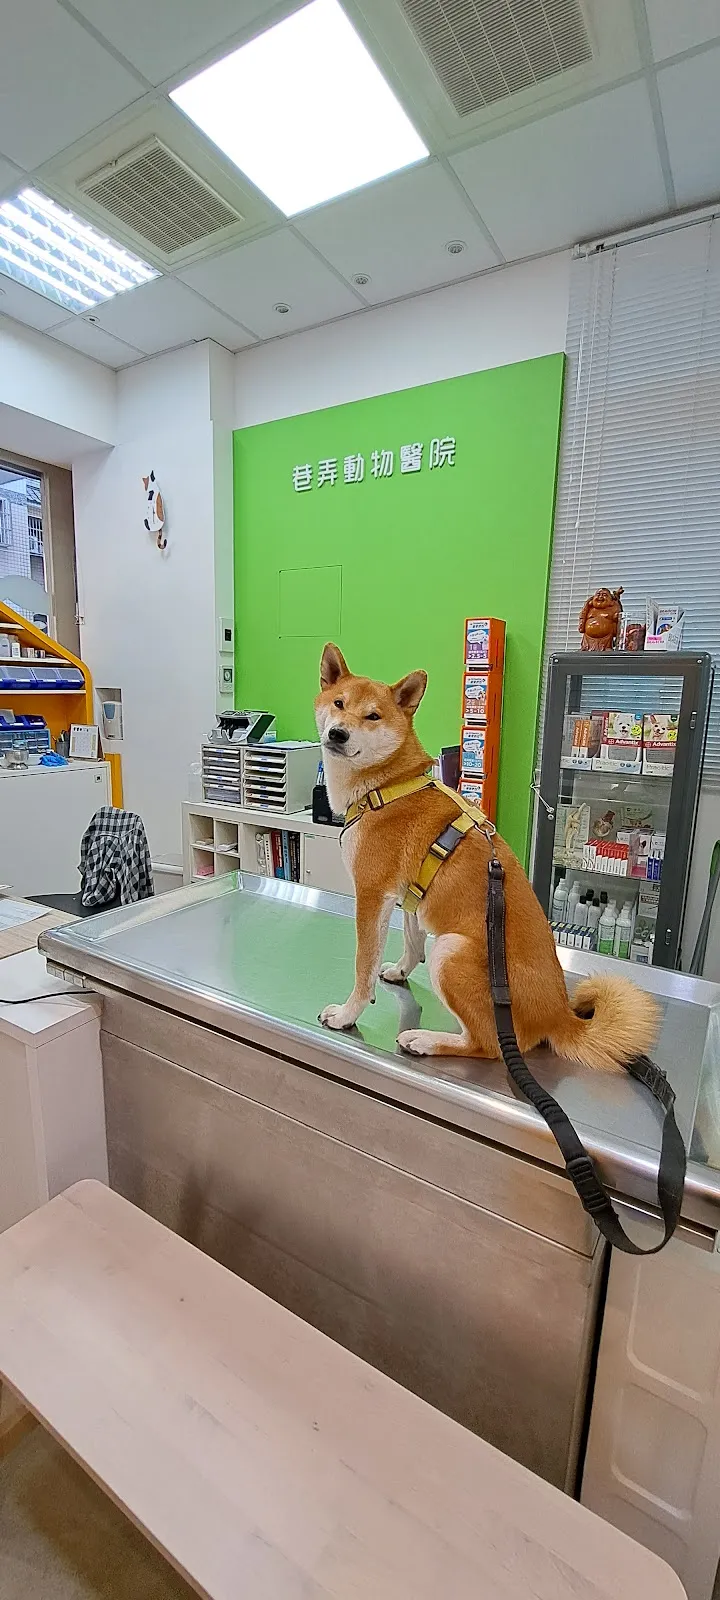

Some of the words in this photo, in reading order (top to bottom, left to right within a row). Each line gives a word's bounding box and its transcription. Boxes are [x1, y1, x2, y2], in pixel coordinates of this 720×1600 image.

[292, 436, 457, 492] 巷弄動物醫院
